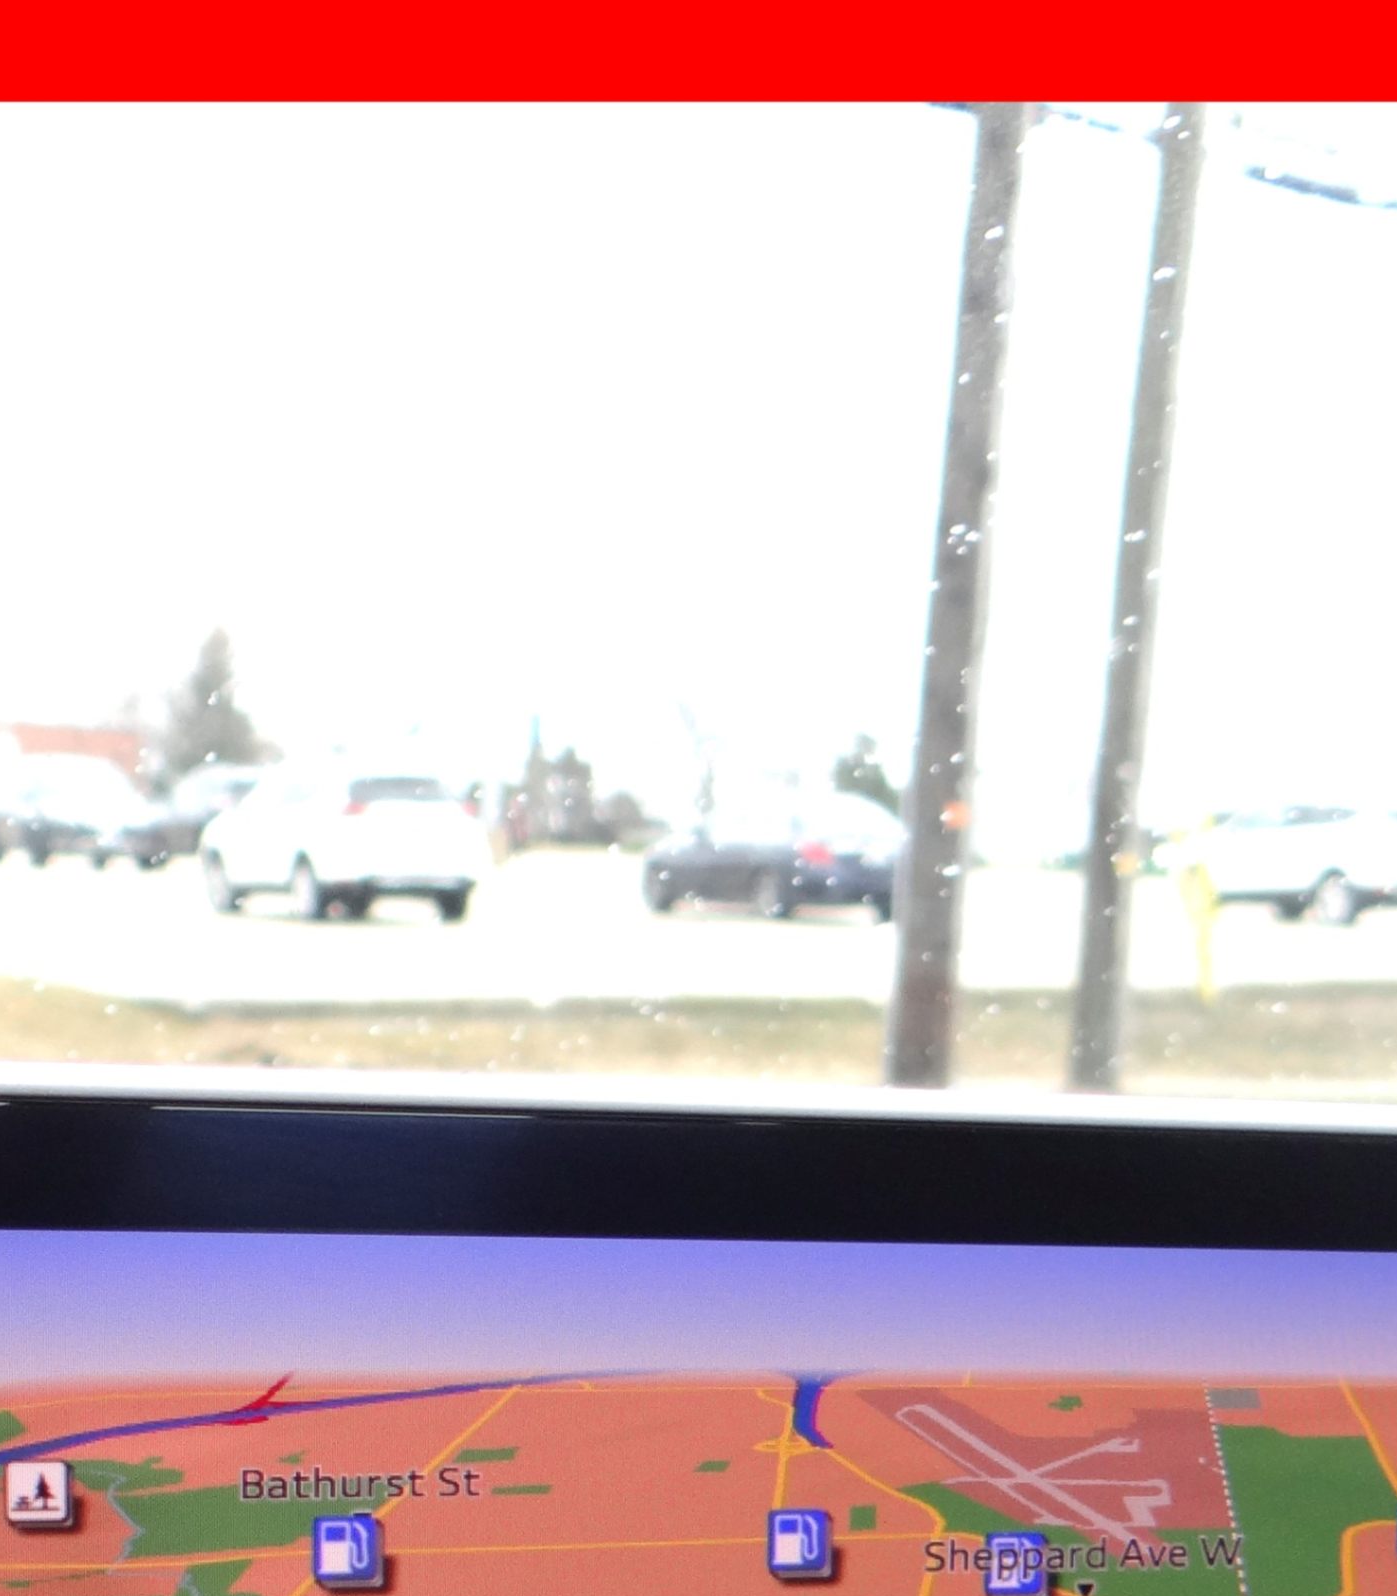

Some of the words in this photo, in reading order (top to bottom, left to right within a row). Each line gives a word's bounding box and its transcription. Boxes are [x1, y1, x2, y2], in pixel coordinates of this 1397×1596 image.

[240, 1466, 425, 1499] Bathurst
[438, 1467, 481, 1497] St
[924, 1537, 1107, 1580] Sheppard
[1120, 1538, 1189, 1568] Ave
[1200, 1536, 1243, 1566] W
